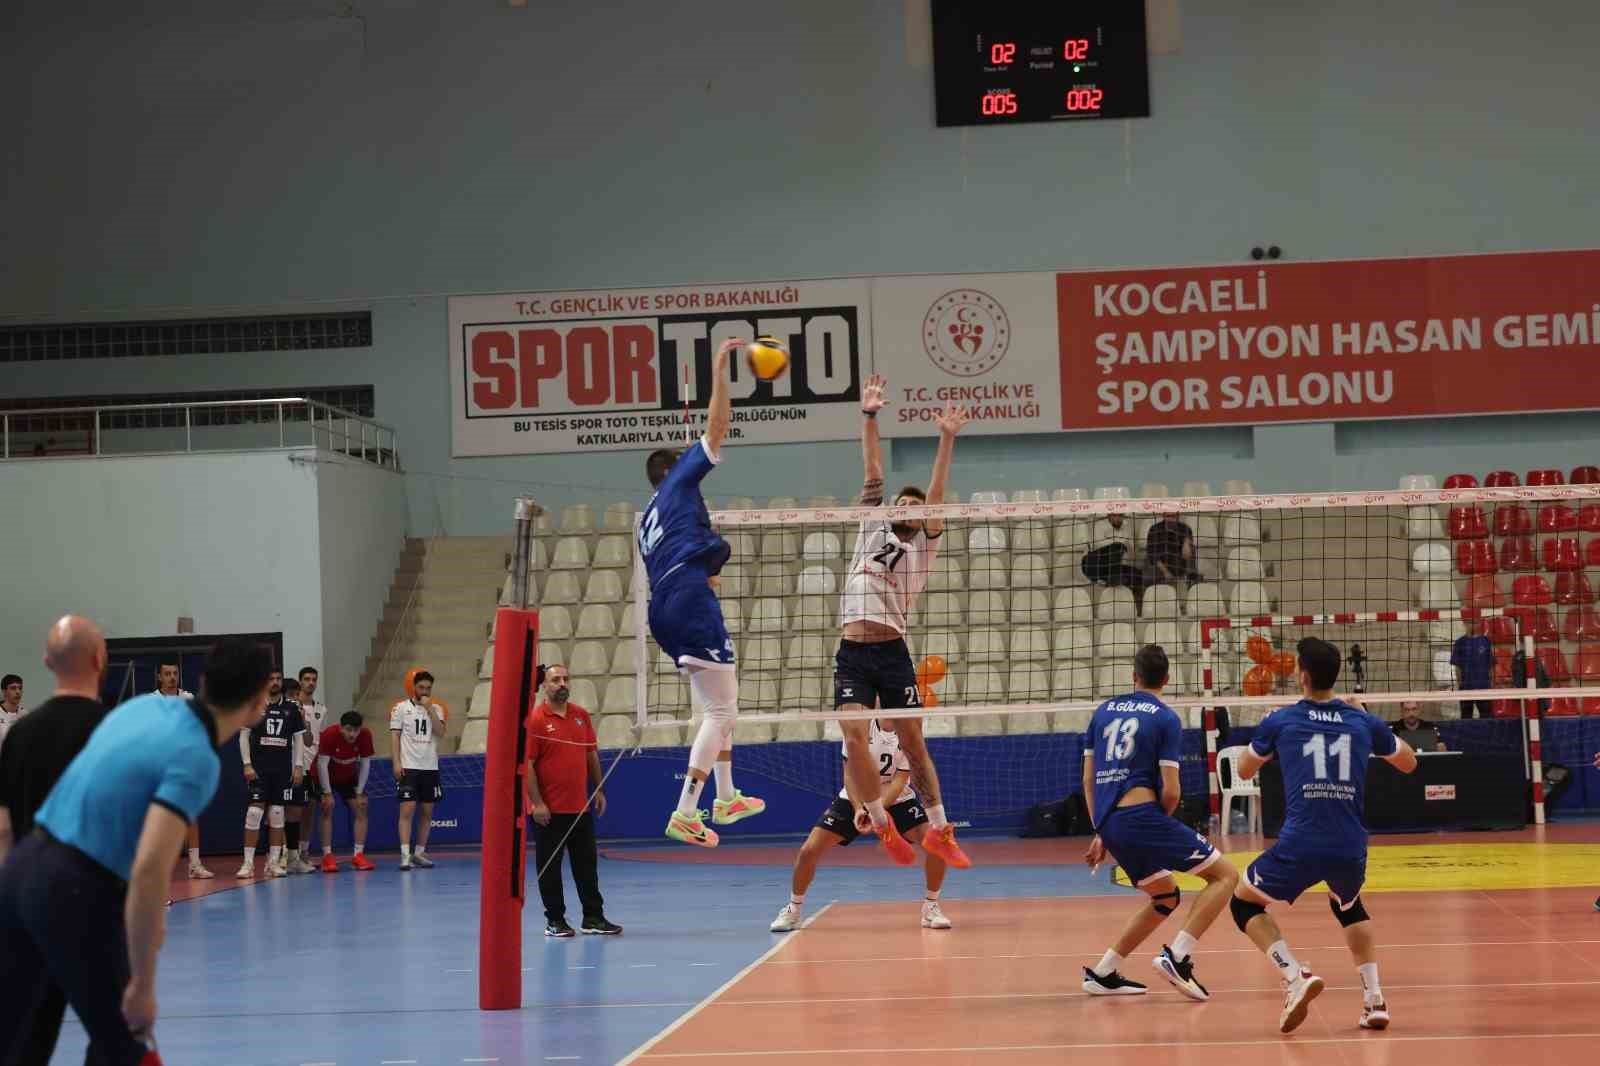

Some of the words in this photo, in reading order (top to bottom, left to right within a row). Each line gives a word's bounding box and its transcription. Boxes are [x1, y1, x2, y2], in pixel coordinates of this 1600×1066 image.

[992, 43, 1015, 64] 02
[1065, 40, 1088, 60] 02
[982, 94, 1017, 115] 005
[1067, 89, 1102, 110] 002
[516, 301, 546, 316] T.C.
[550, 294, 624, 316] GENÇLİK
[628, 296, 649, 310] VE
[654, 293, 700, 311] SPOR
[704, 287, 799, 307] BAKANLIĞI
[1094, 270, 1267, 317] KOCAELİ
[1095, 319, 1320, 373] ŞAMPİYON
[1333, 317, 1481, 355] HASAN
[1493, 303, 1600, 348] GEMİ
[903, 387, 932, 402] T.C.
[937, 382, 1009, 404] GENÇLİK
[1013, 383, 1034, 398] VE
[1096, 379, 1211, 414] SPOR
[1220, 370, 1394, 409] SALONU
[514, 421, 530, 432] BU
[533, 418, 567, 431] TESİS
[570, 418, 602, 430] SPOR
[605, 417, 638, 428] TOTO
[641, 412, 696, 427] TEŞKİLAT
[701, 409, 807, 424] MÜRLÜĞÜ'NÜN
[898, 407, 943, 422] SPOR
[949, 402, 1040, 421] KANLIĞI
[577, 431, 663, 446] KATKILARIYLA
[1107, 701, 1160, 714] B.GÜLMEN
[266, 718, 283, 736] 67
[415, 719, 427, 735] 14
[1103, 717, 1139, 761] 13
[880, 753, 893, 776] 2
[1303, 734, 1351, 781] 11
[430, 818, 457, 827] OCAELİ
[909, 807, 924, 819] 2
